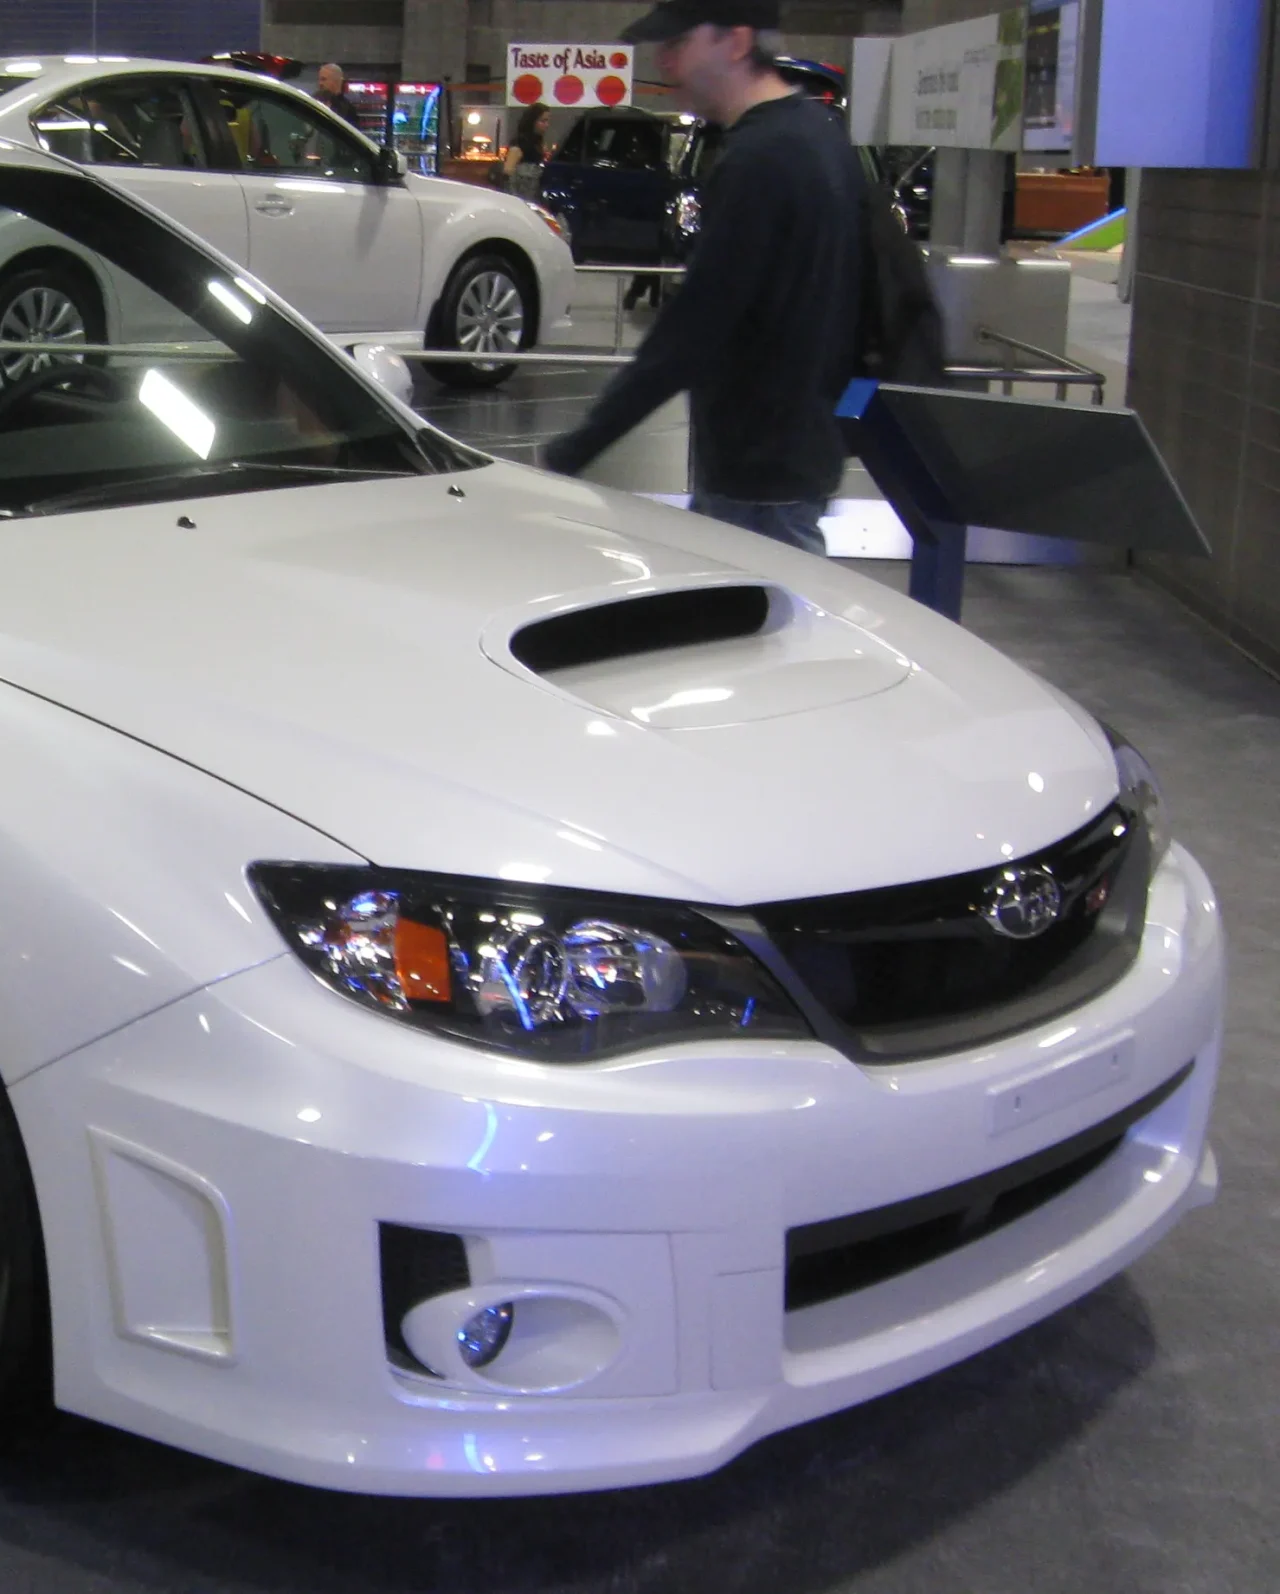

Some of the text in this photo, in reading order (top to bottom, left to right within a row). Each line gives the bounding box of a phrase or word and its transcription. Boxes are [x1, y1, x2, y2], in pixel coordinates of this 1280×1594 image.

[511, 47, 607, 75] Taste of Asia
